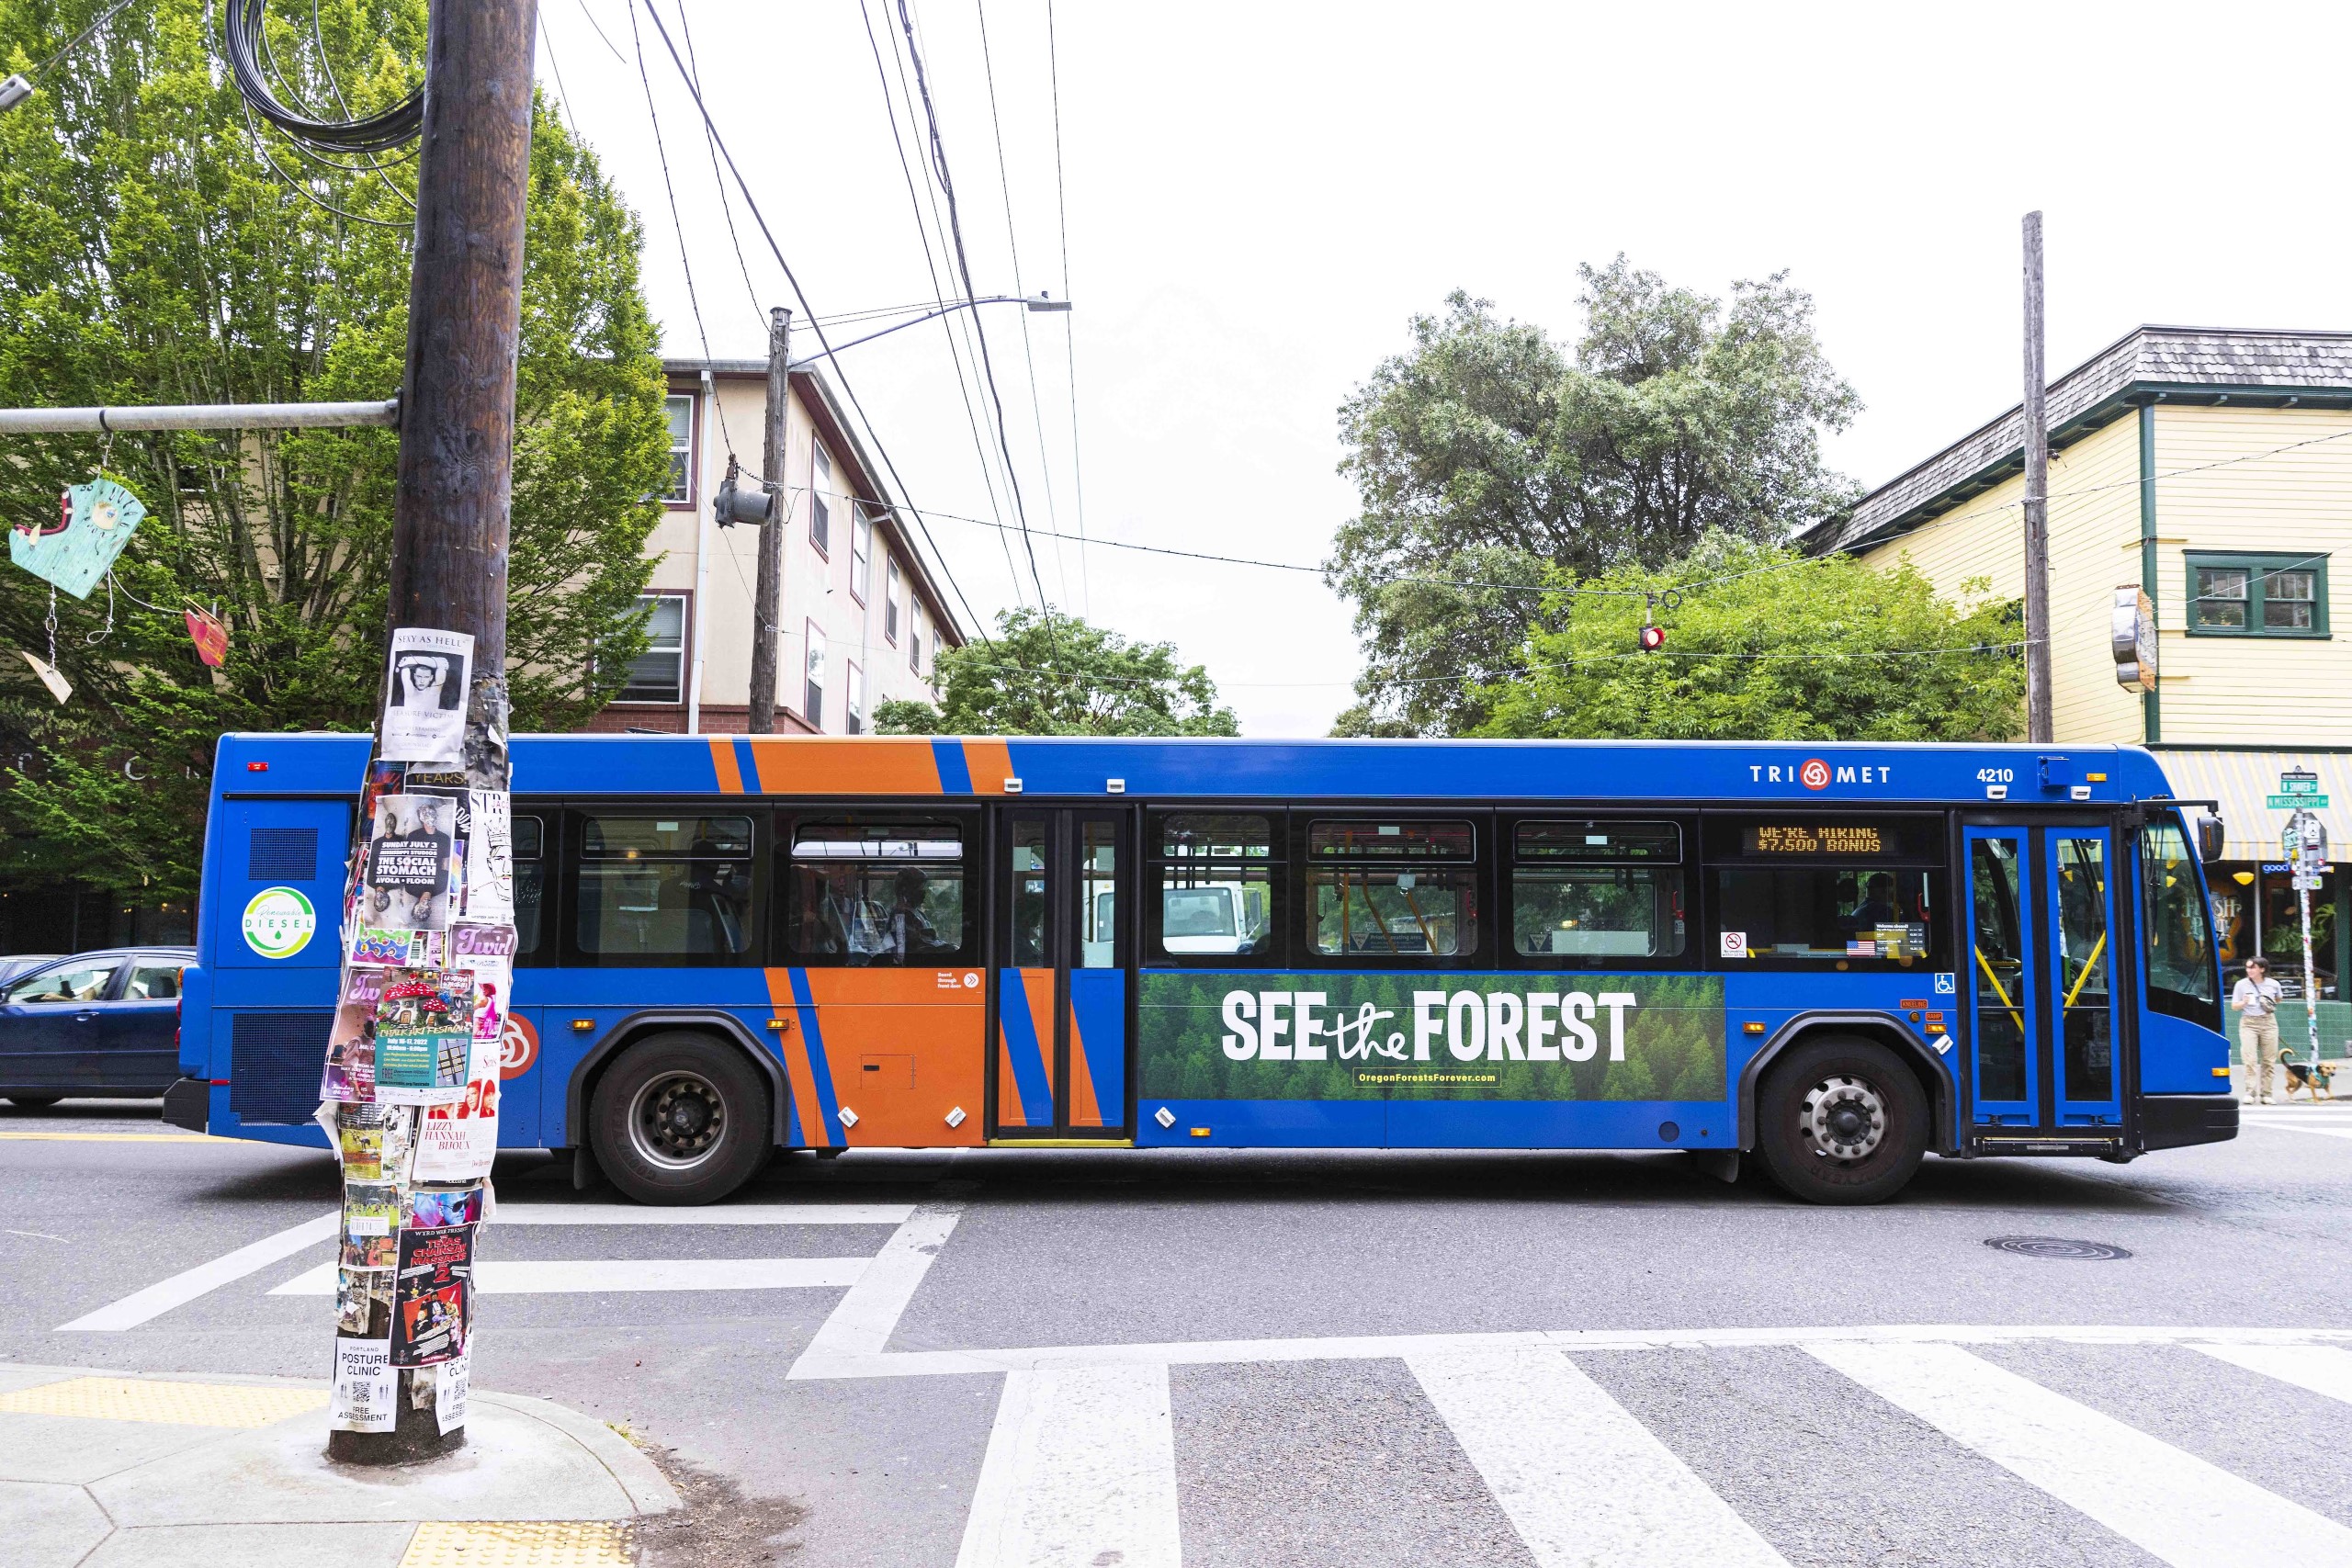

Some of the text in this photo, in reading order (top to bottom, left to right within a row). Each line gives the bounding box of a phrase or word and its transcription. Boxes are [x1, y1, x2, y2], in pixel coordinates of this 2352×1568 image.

[420, 636, 431, 644] AS
[1976, 768, 2014, 783] 4210
[2267, 797, 2274, 807] N
[2274, 796, 2319, 807] MISSISSIPPI
[1758, 827, 1878, 839] WE'RE HIRING
[1758, 838, 1882, 852] $7,500 BONUS
[379, 857, 437, 866] THE SOCIAL
[376, 865, 436, 876] STOMACH
[2262, 863, 2290, 874] good
[244, 919, 312, 929] DIESEL
[456, 928, 514, 955] Twirl
[379, 1025, 466, 1037] CHALK ART FESTIVAL
[1221, 989, 1637, 1062] SEE the FOREST
[1359, 1073, 1496, 1083] OregonForestsForever.com
[331, 1082, 354, 1091] Sunday
[426, 1122, 454, 1131] LIZZY
[424, 1131, 467, 1140] HANNAH
[438, 1141, 470, 1150] BIJOUX
[426, 1236, 462, 1248] TEXAS
[413, 1243, 468, 1258] CHAINSAW
[434, 1267, 450, 1283] 2
[342, 1352, 389, 1364] POSTURE
[346, 1365, 381, 1376] CLINIC
[352, 1405, 370, 1415] FREE
[337, 1412, 388, 1422] ASSESSMENT
